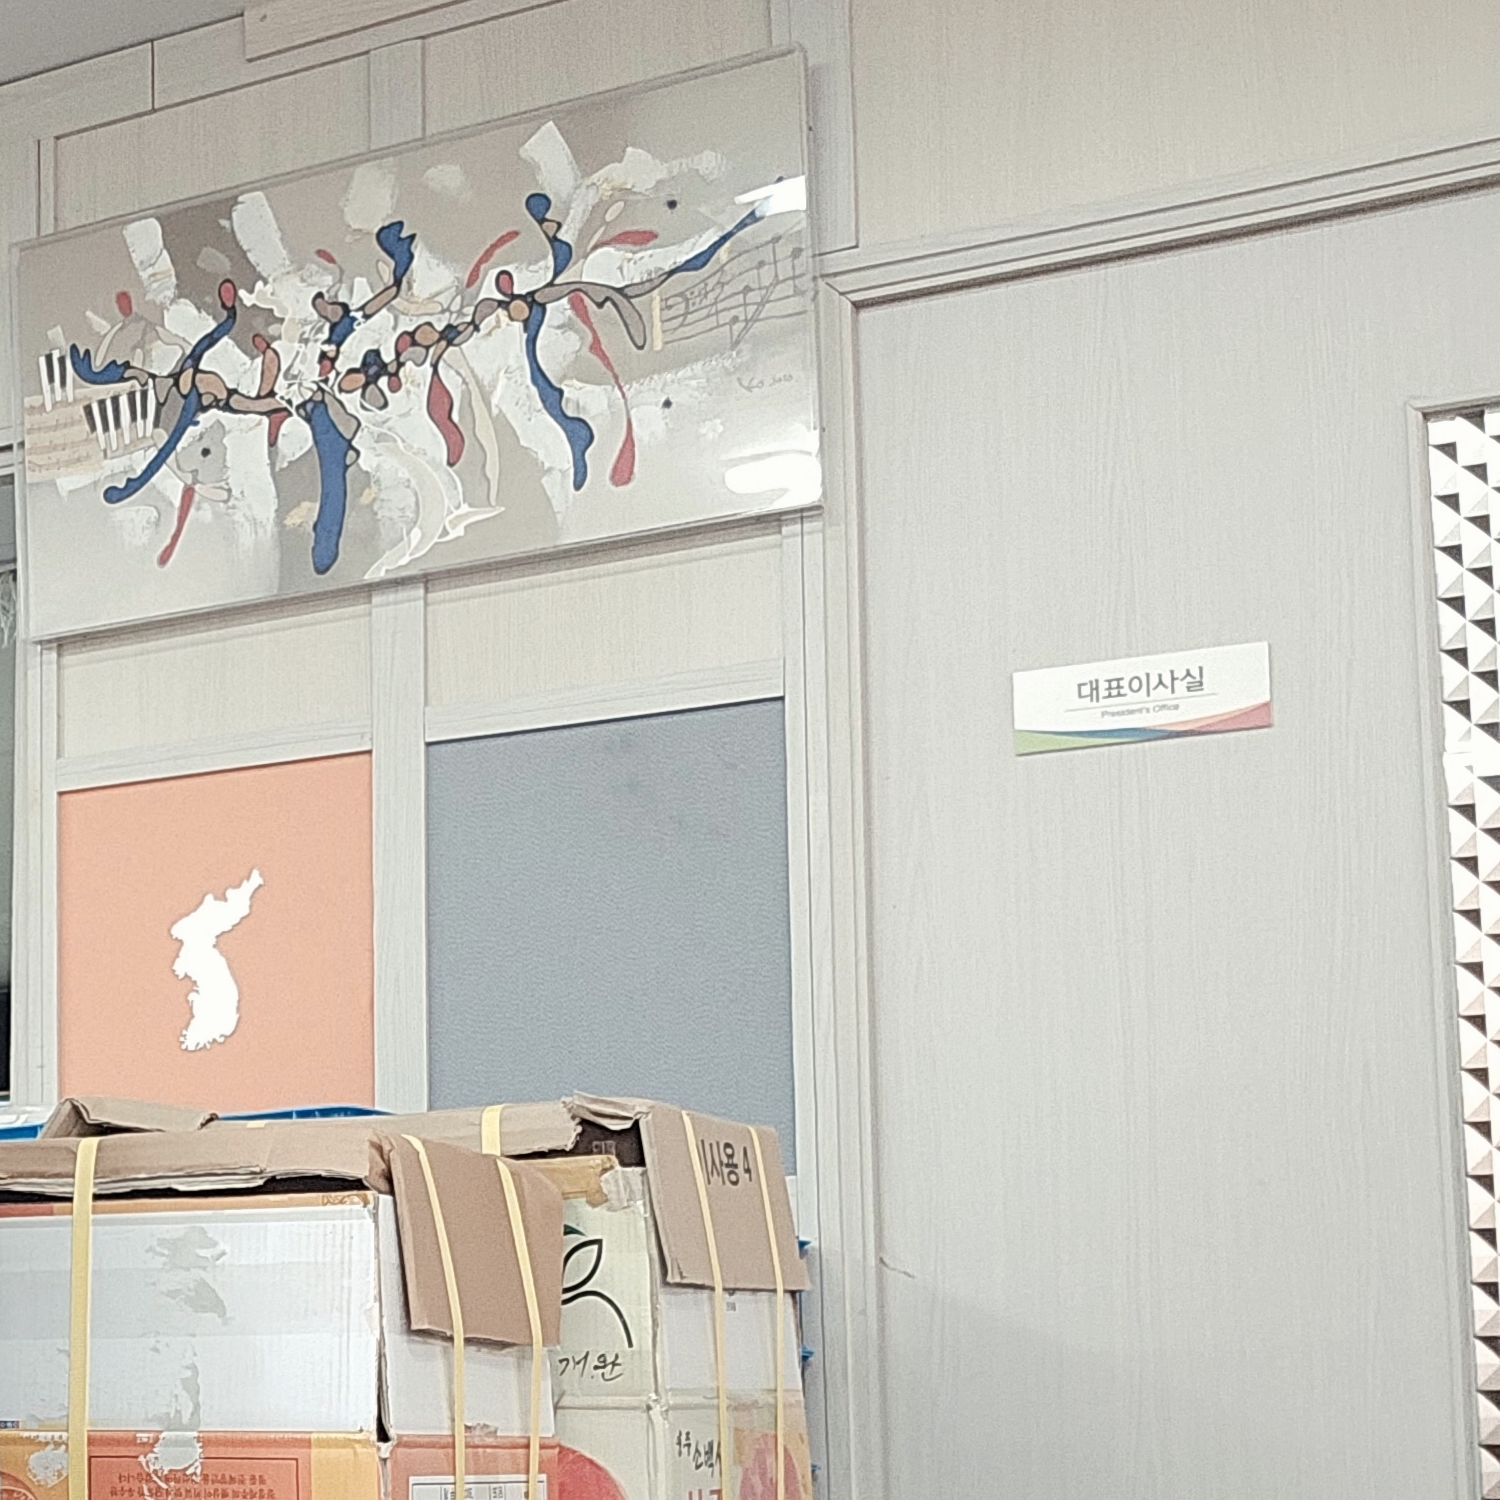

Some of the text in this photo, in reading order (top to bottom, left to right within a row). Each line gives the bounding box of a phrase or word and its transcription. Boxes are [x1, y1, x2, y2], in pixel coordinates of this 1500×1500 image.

[1076, 665, 1205, 703] 대표이사실
[1100, 703, 1180, 719] President's Office
